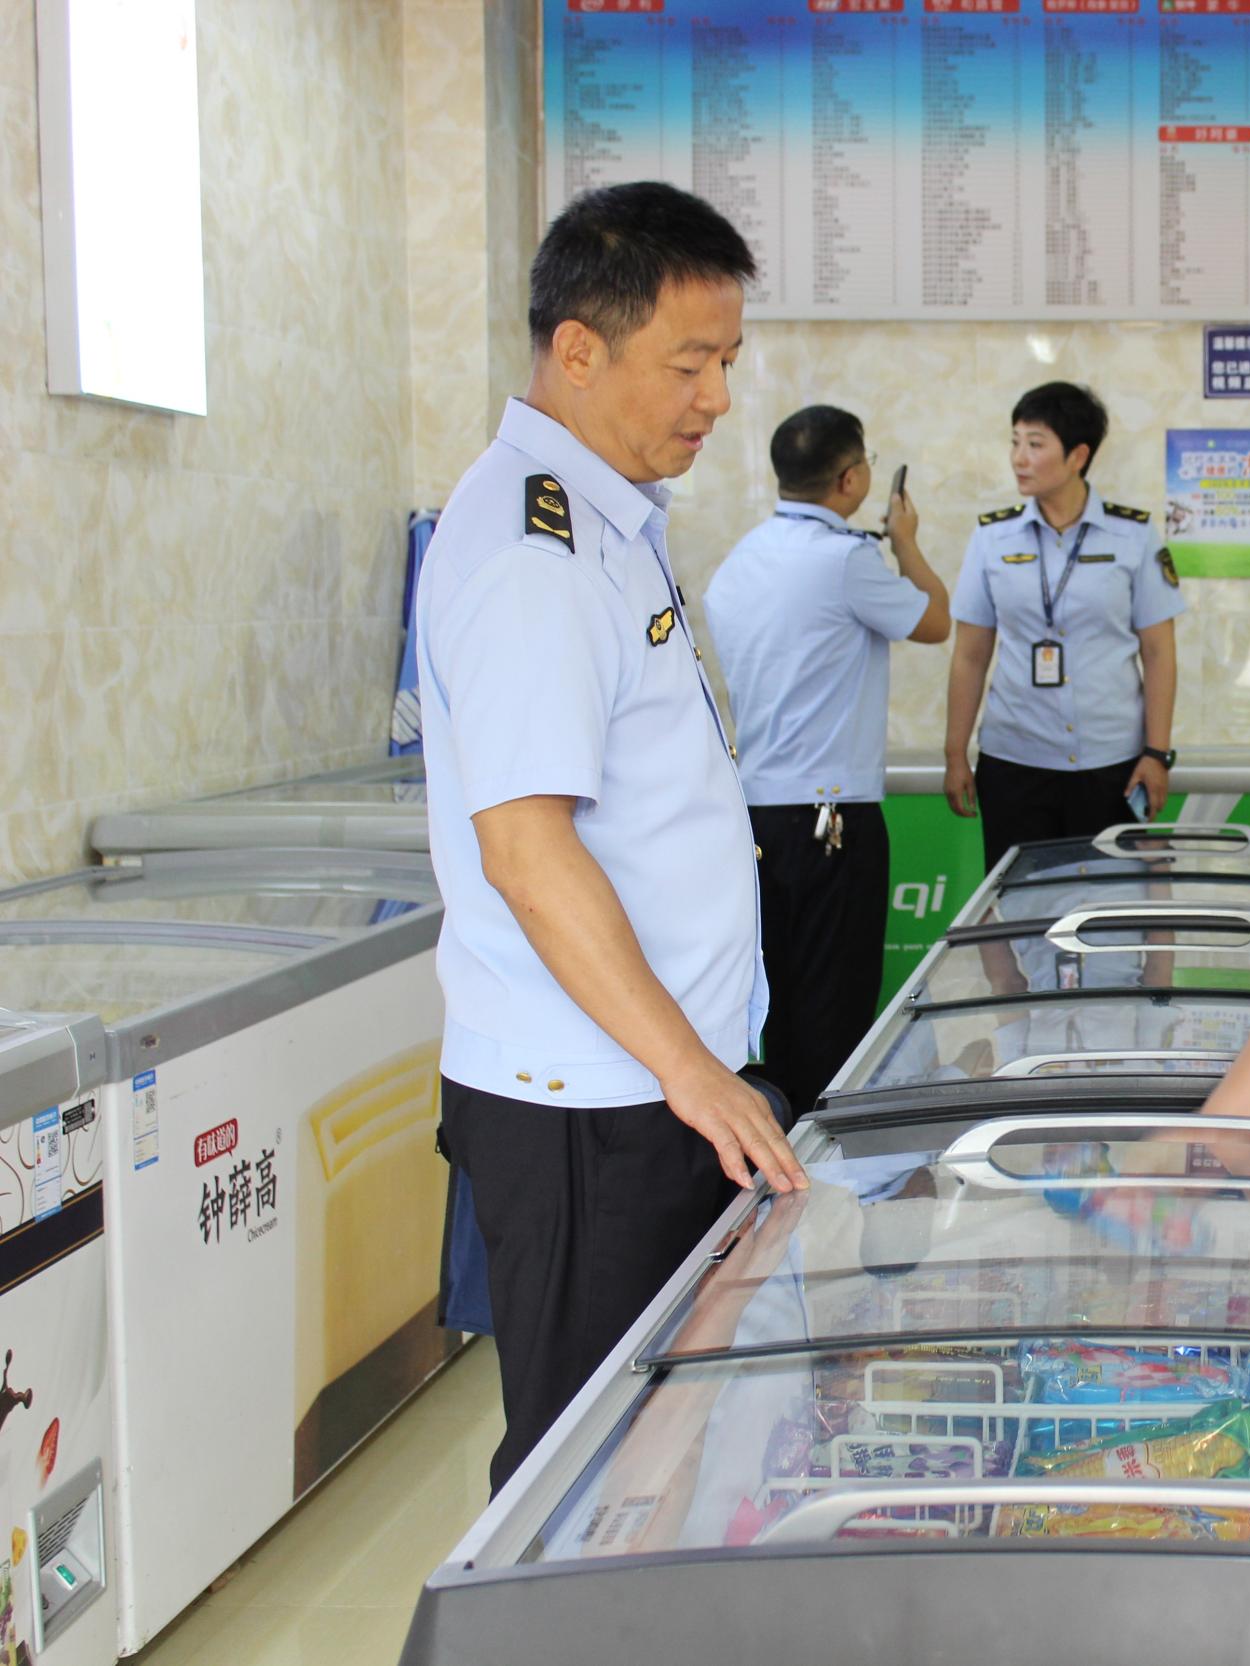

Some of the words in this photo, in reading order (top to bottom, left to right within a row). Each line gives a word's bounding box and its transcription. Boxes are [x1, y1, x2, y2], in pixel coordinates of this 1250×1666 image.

[198, 1122, 236, 1163] 有味道的
[198, 1148, 278, 1245] 钟薛高
